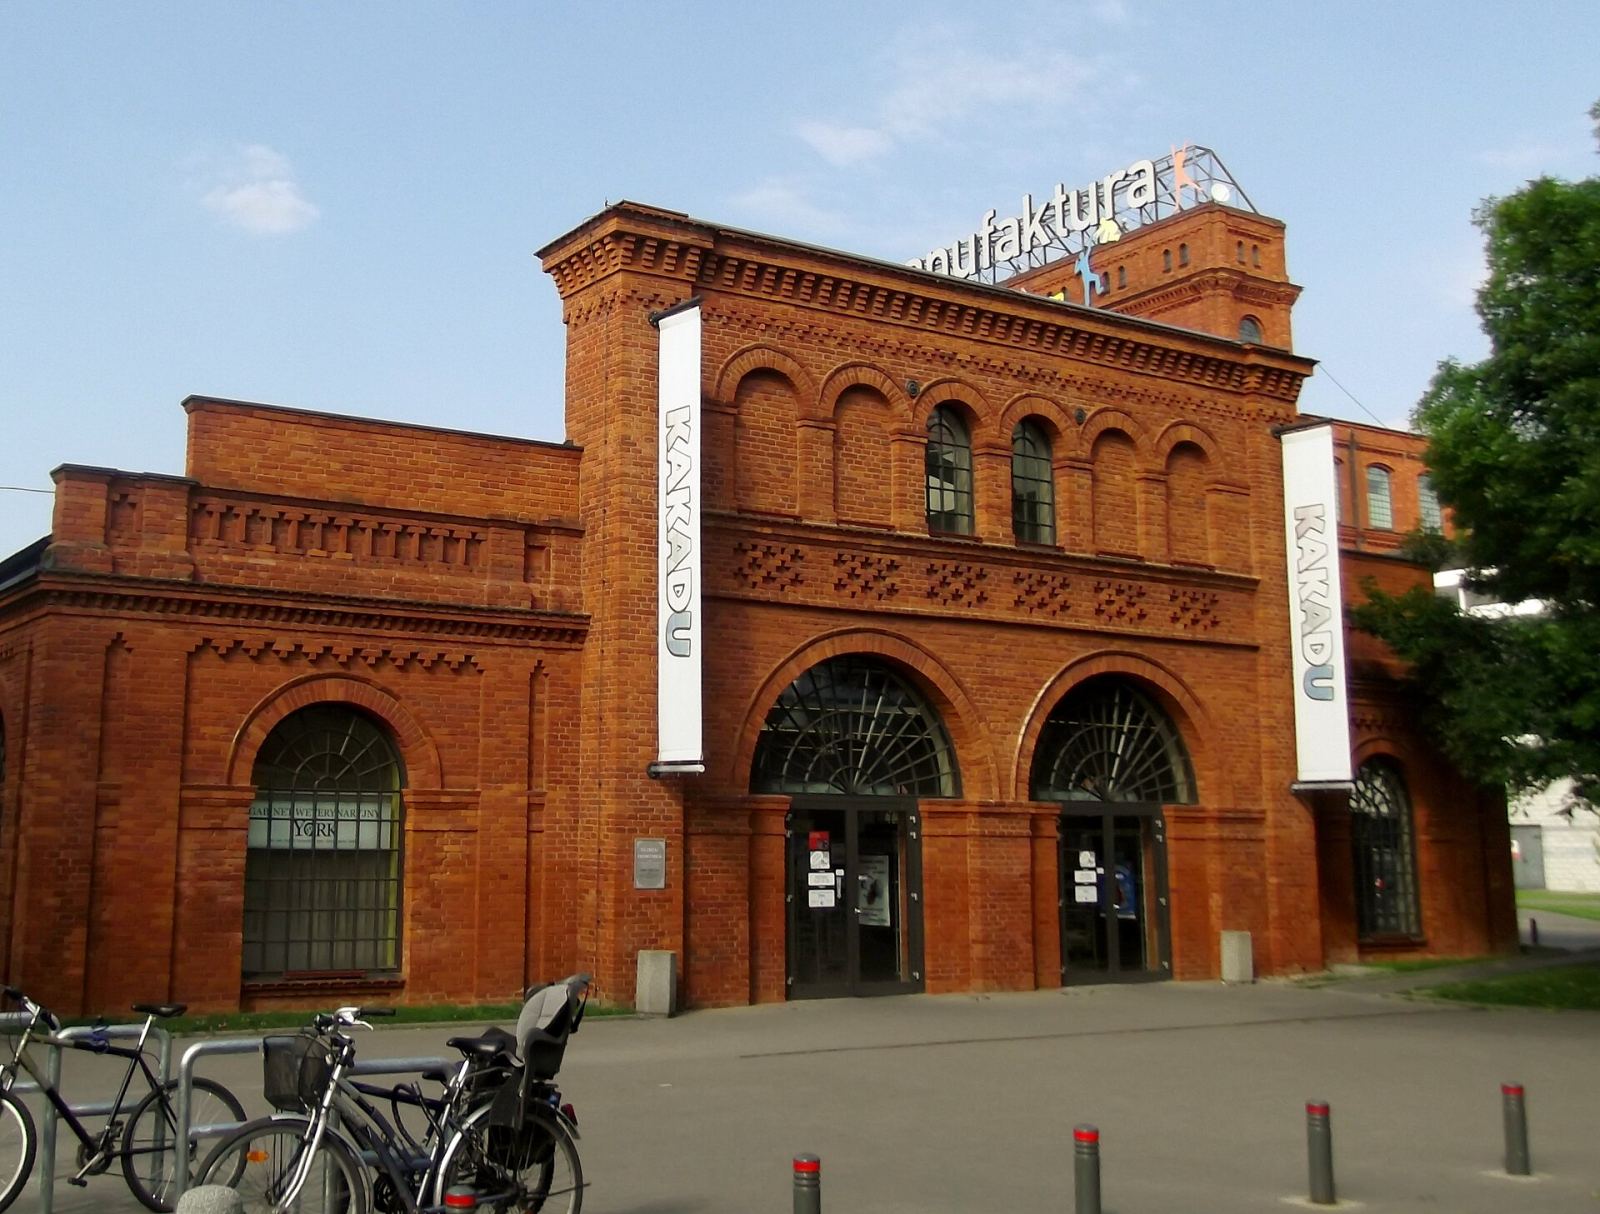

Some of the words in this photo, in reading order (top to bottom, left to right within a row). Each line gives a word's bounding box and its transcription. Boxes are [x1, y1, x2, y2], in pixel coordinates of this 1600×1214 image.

[906, 159, 1157, 279] nufaktura
[666, 405, 691, 657] KAKADU
[1294, 503, 1335, 701] KAKADU
[249, 807, 292, 817] GABNET
[296, 808, 381, 818] WEERYNARJNY
[293, 820, 337, 837] YORK
